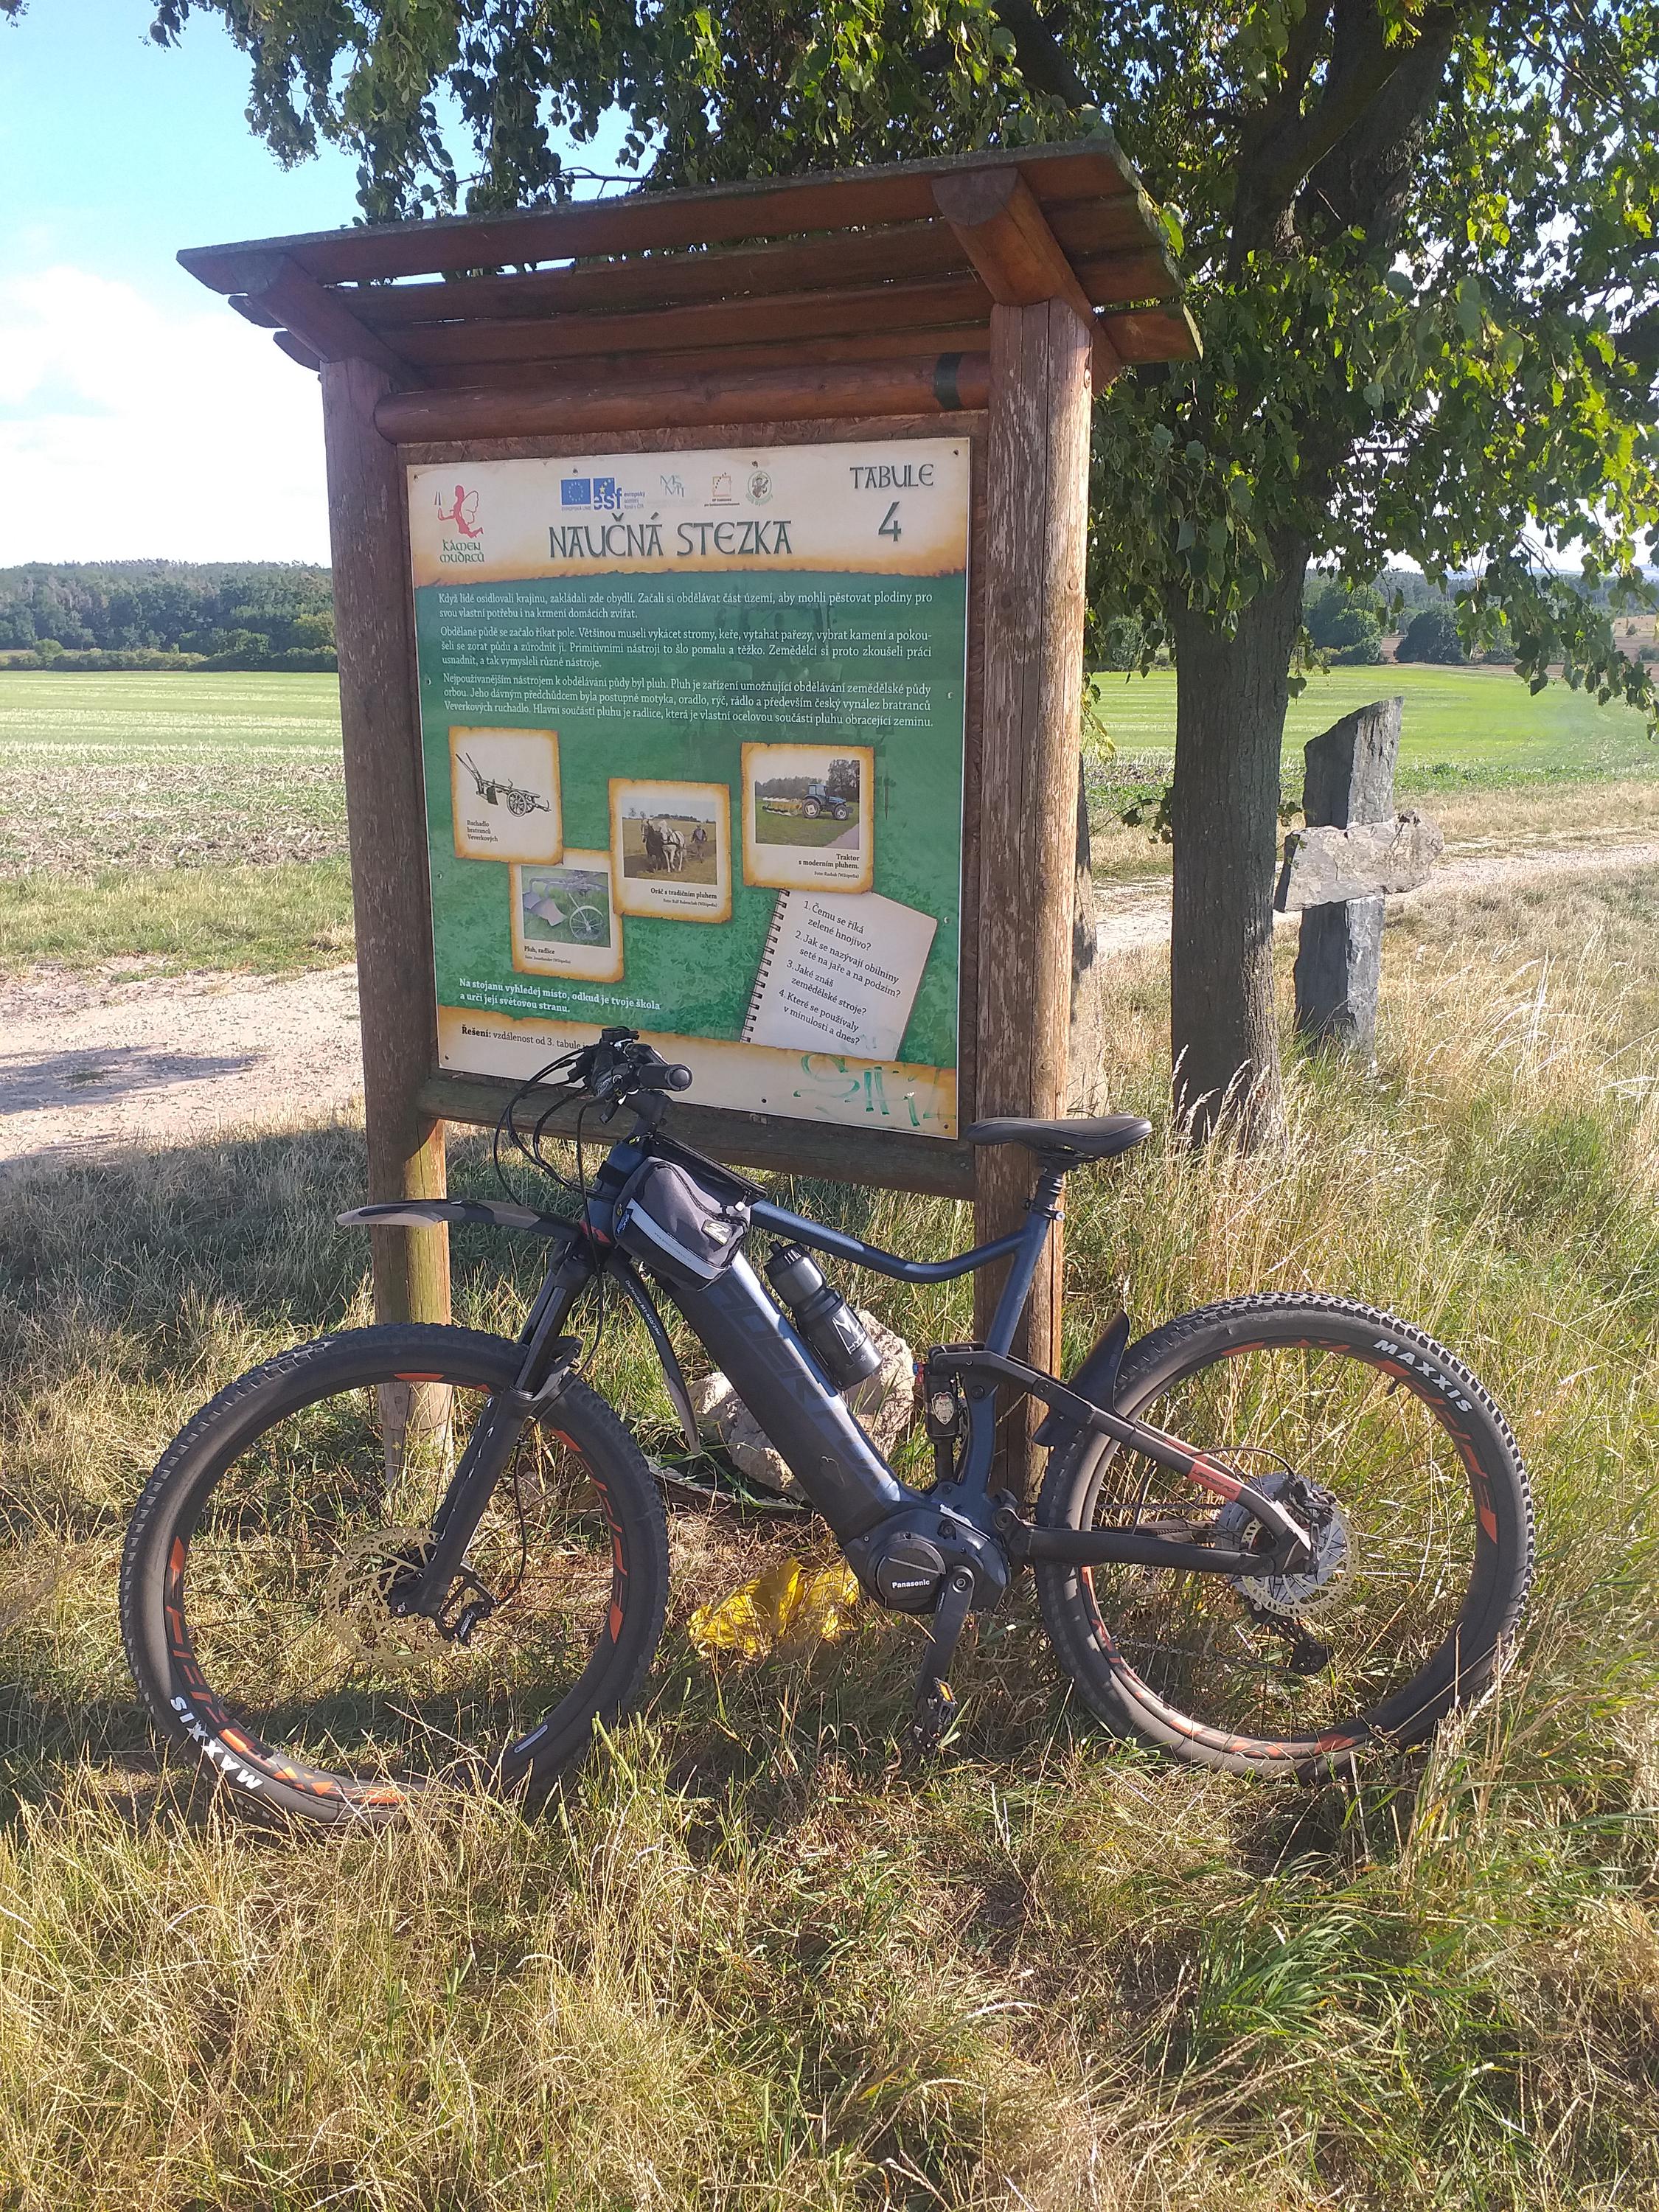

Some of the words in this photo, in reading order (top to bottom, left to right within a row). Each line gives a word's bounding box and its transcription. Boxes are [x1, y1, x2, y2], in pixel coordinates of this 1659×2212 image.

[849, 464, 935, 490] TABULE
[549, 512, 664, 559] NAUČNÁ
[677, 519, 793, 556] STEZKA
[877, 501, 902, 543] 4
[550, 592, 587, 603] zakládali
[589, 592, 604, 603] zde
[606, 592, 636, 606] obydlí.
[638, 591, 664, 603] Začali
[667, 593, 674, 603] si
[676, 591, 721, 603] obdělávat
[723, 593, 742, 603] část
[744, 592, 776, 605] území,
[778, 591, 796, 606] aby
[798, 591, 827, 603] mohli
[829, 592, 872, 606] pěstovat
[874, 590, 912, 606] plodiny
[915, 594, 933, 605] pro
[440, 625, 477, 636] Obdělané
[478, 626, 498, 639] půdě
[509, 626, 535, 637] začalo
[535, 627, 556, 637] říkat
[557, 627, 577, 640] pole.
[578, 627, 616, 638] Většinou
[618, 627, 646, 639] museli
[648, 627, 681, 641] vykácet
[683, 630, 717, 642] stromy,
[718, 627, 741, 641] keře,
[743, 627, 779, 642] vytahat
[781, 630, 814, 643] pařezy,
[816, 628, 848, 643] vybrat
[849, 628, 886, 640] kamení
[888, 632, 894, 640] a
[896, 628, 932, 644] pokou-
[570, 641, 624, 653] Primitivními
[627, 643, 660, 656] nástroji
[663, 644, 672, 654] to
[675, 642, 689, 654] šlo
[692, 643, 726, 657] pomalu
[737, 644, 765, 655] těžko.
[768, 644, 817, 655] Zemědělci
[820, 644, 829, 656] si
[832, 647, 859, 659] proto
[863, 644, 903, 656] zkoušeli
[907, 646, 931, 660] práci
[562, 675, 607, 687] obdělávání
[608, 676, 630, 690] půdy
[631, 677, 644, 690] byl
[646, 677, 669, 691] pluh.
[670, 678, 691, 689] Pluh
[692, 679, 700, 692] je
[702, 680, 739, 690] zařízení
[740, 681, 792, 695] umožňující
[793, 681, 846, 692] obdělávání
[847, 682, 904, 694] zemědělské
[905, 683, 931, 698] půdy
[599, 693, 639, 705] postupně
[640, 692, 676, 706] motyka,
[678, 693, 709, 706] oradlo,
[712, 695, 728, 708] rýč,
[730, 695, 754, 706] rádlo
[756, 698, 762, 706] a
[763, 695, 813, 709] především
[814, 697, 841, 712] český
[842, 698, 880, 712] vynález
[882, 698, 931, 711] bratranců
[633, 707, 664, 720] radlice,
[665, 707, 689, 719] která
[689, 709, 698, 723] je
[700, 709, 731, 720] vlastní
[732, 710, 773, 722] ocelovou
[775, 712, 813, 723] součástí
[815, 712, 844, 726] pluhu
[845, 713, 891, 728] obracející
[893, 716, 933, 727] zeminu.
[802, 859, 834, 867] moderním
[835, 861, 860, 869] pluhem.
[835, 853, 860, 861] Traktor
[668, 889, 695, 897] tradičním
[696, 891, 717, 900] pluhem
[804, 900, 811, 911] 1.
[812, 902, 835, 922] Čemu
[836, 917, 846, 926] se
[847, 919, 864, 934] říká
[807, 919, 835, 935] zelené
[835, 928, 872, 951] hnojivo?
[794, 930, 802, 940] 2.
[802, 934, 818, 947] Jak
[818, 943, 828, 952] se
[829, 947, 864, 968] nazývají
[864, 963, 900, 985] obilniny
[786, 959, 794, 970] 3.
[794, 963, 814, 978] Jaké
[814, 974, 834, 987] znáš
[799, 948, 817, 961] seté
[818, 956, 828, 966] na
[827, 960, 845, 974] jaře
[852, 973, 863, 982] na
[863, 978, 901, 998] podzim?
[459, 978, 471, 987] Na
[472, 980, 504, 992] stojanu
[504, 984, 541, 998] vyhledej
[542, 988, 570, 1001] místo,
[571, 992, 599, 1003] odkud
[601, 994, 610, 1006] je
[611, 997, 634, 1009] tvoje
[636, 998, 661, 1010] škola
[466, 992, 483, 1002] urči
[484, 993, 498, 1006] její
[499, 997, 538, 1009] světovou
[538, 1002, 571, 1012] stranu.
[791, 978, 838, 1004] zemědělské
[838, 999, 867, 1015] stroje?
[779, 989, 787, 998] 4.
[787, 992, 809, 1009] Které
[810, 1005, 819, 1013] se
[819, 1009, 859, 1033] používaly
[462, 1023, 492, 1038] Řešení:
[493, 1031, 534, 1044] vzdálenost
[535, 1036, 546, 1046] od
[547, 1037, 554, 1046] 3.
[790, 1009, 829, 1032] minulosti
[835, 1029, 860, 1046] dnes?
[1373, 1339, 1472, 1412] MAXXIS
[891, 1579, 931, 1589] Panasonic
[170, 1696, 263, 1790] MAXXIS
